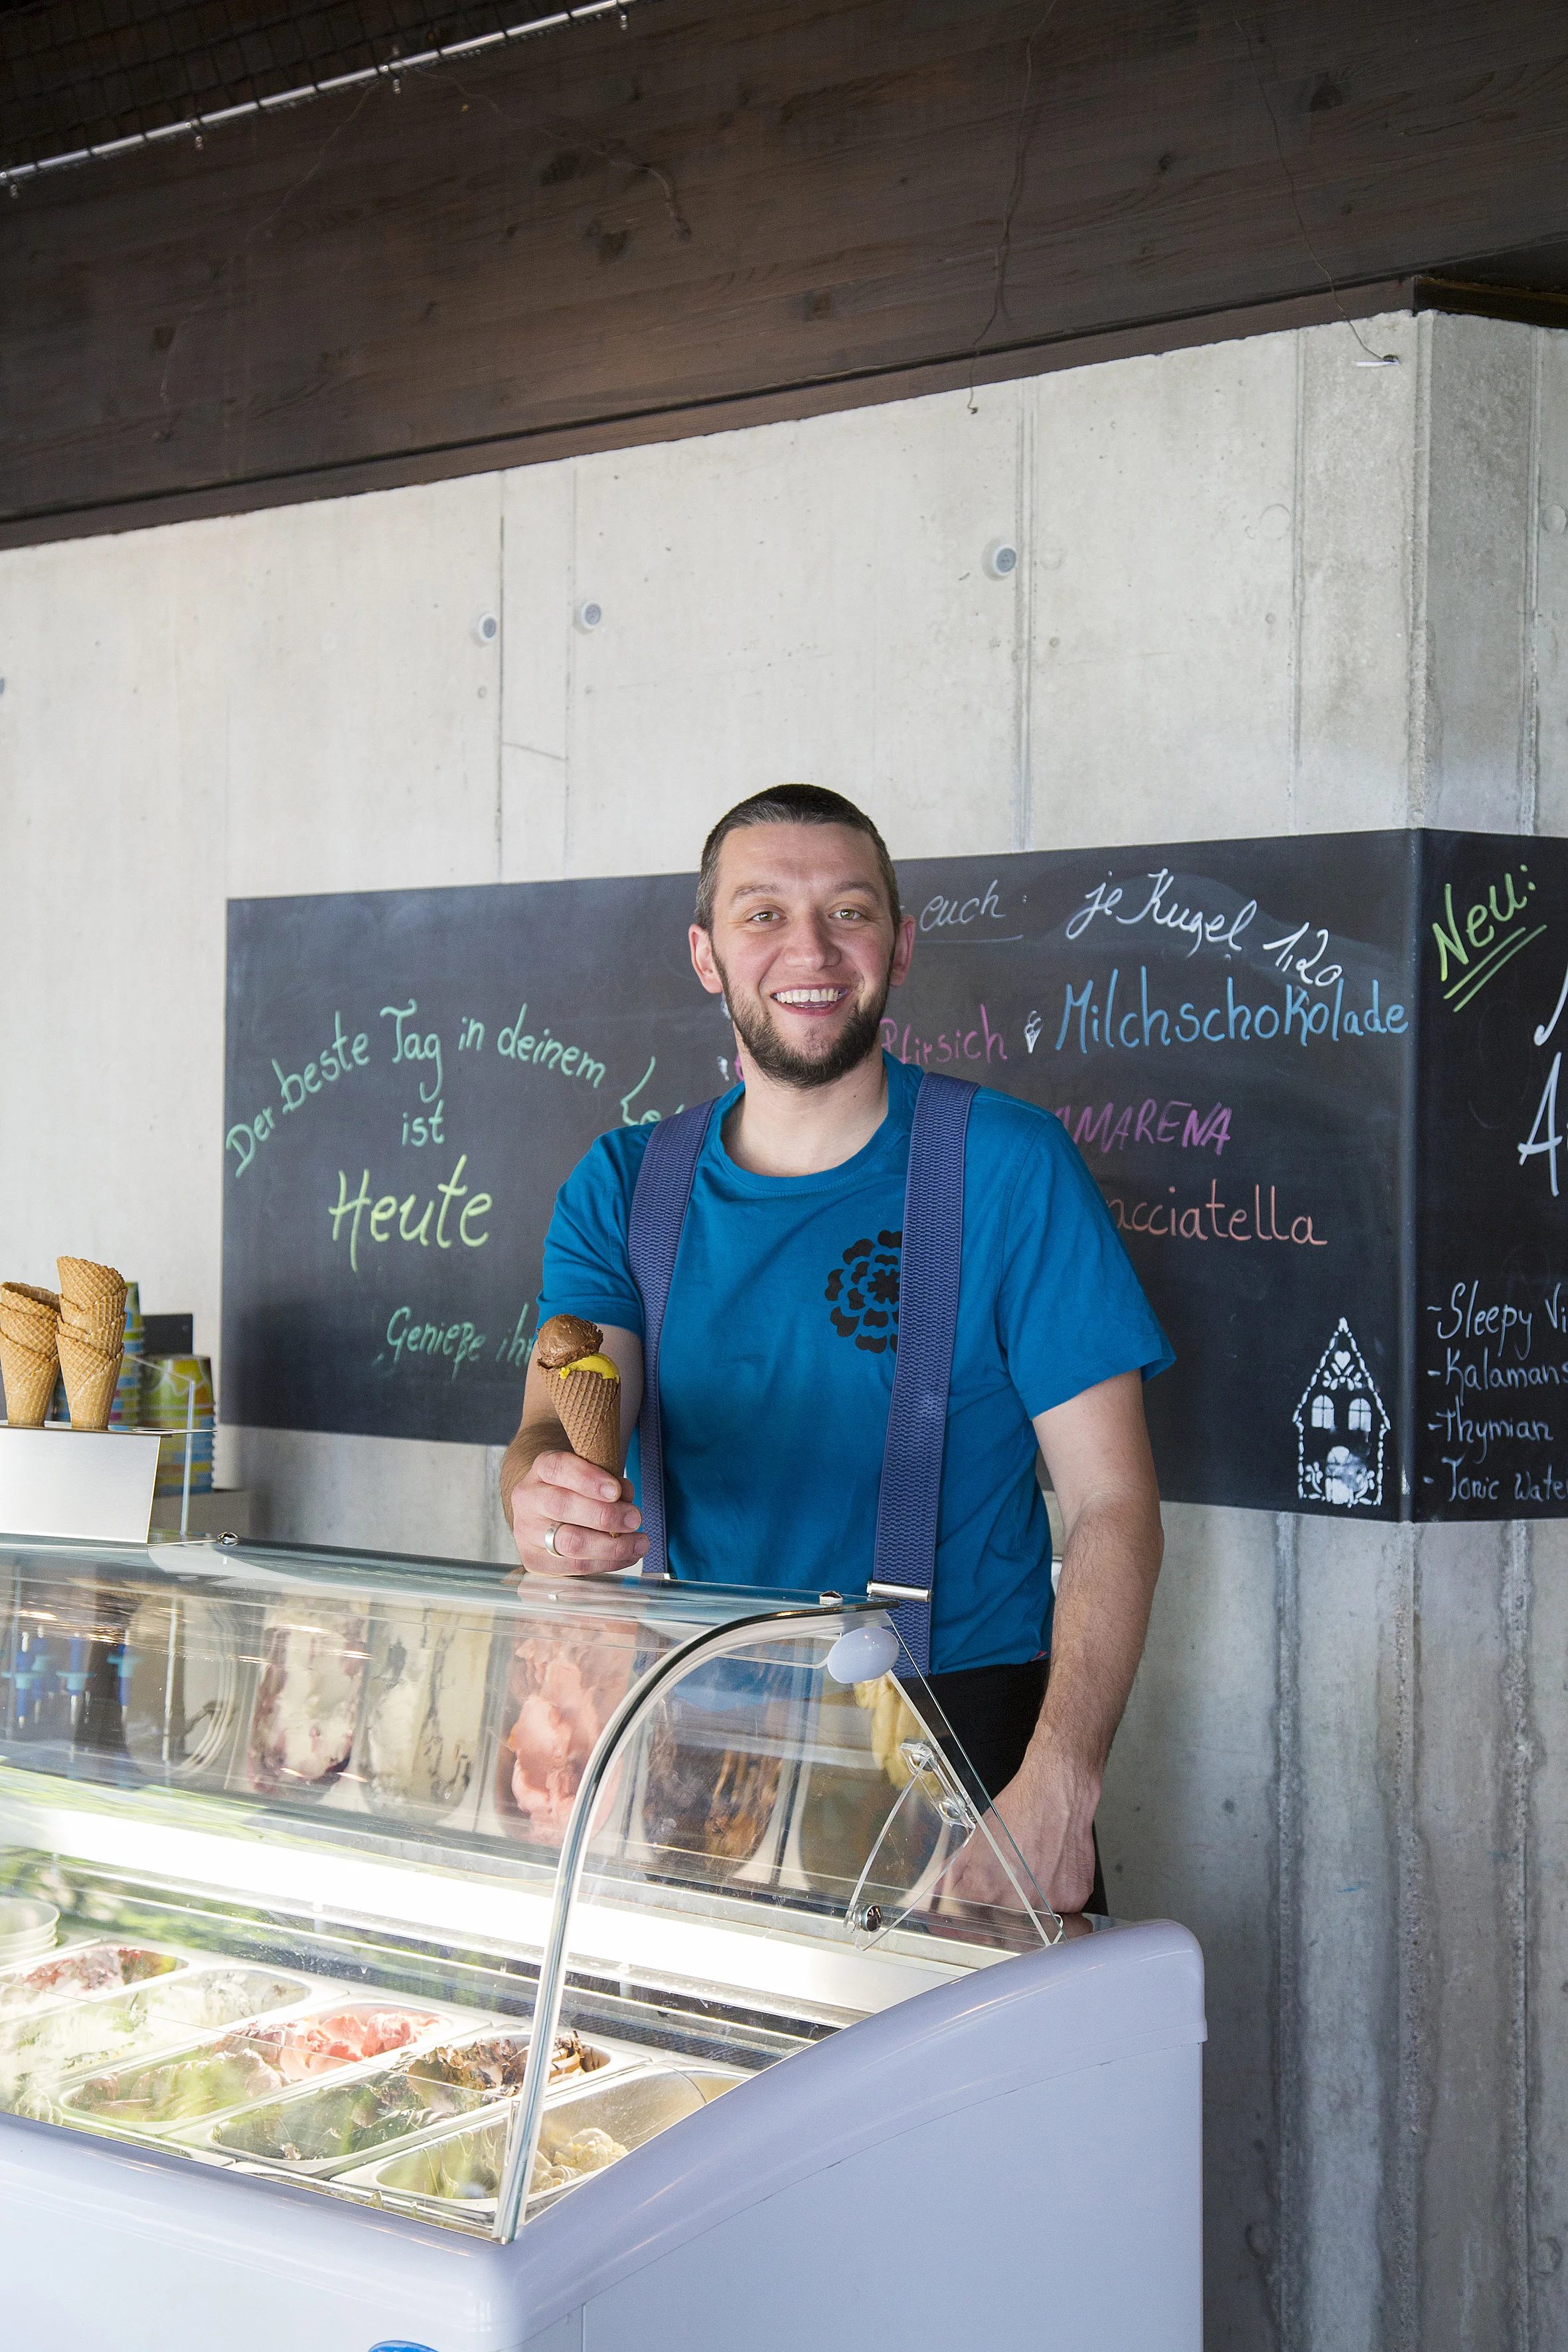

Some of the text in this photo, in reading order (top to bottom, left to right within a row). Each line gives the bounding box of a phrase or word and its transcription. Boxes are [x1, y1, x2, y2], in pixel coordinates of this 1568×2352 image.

[1066, 871, 1123, 939] je
[1117, 868, 1257, 958] Kugel
[226, 1107, 275, 1178] Der
[272, 1010, 370, 1114] beste
[380, 998, 442, 1103] Tag
[458, 1017, 485, 1052] in
[497, 1002, 606, 1088] deinem
[401, 1099, 444, 1146] ist
[328, 1154, 493, 1272] Heute
[1106, 1179, 1328, 1245] acciatella
[1515, 1464, 1568, 1502] Wate
